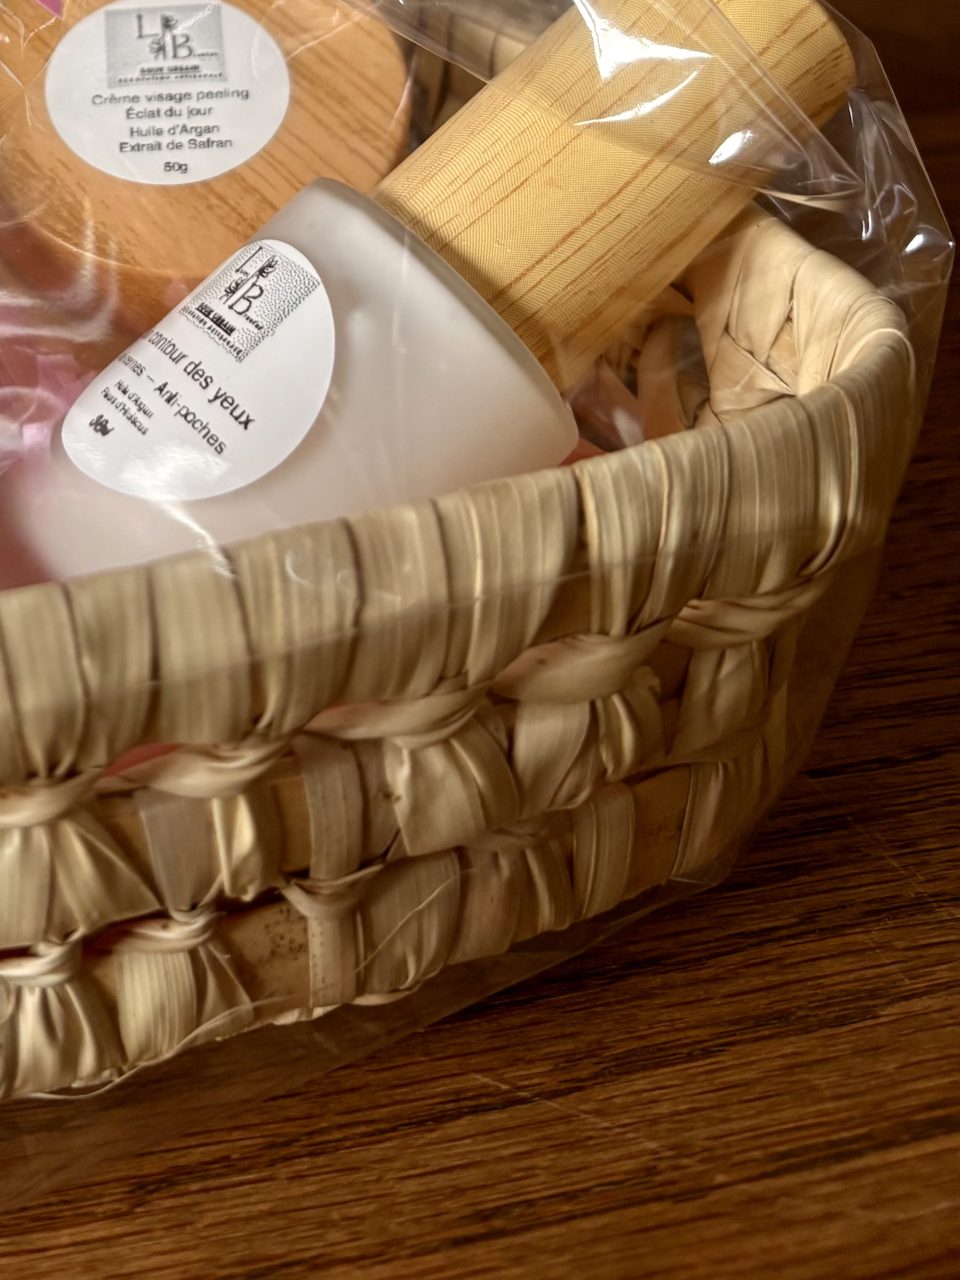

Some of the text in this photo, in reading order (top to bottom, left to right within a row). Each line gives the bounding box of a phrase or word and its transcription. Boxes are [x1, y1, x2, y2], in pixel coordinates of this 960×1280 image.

[91, 88, 250, 106] Crème visage peeling
[125, 105, 214, 120] Éclat du jour
[129, 123, 220, 138] Huile d'Argan
[119, 137, 233, 153] Extrait de Safran
[163, 161, 189, 174] 50g
[147, 330, 189, 365] contour
[183, 360, 214, 390] des
[207, 386, 256, 431] yeux
[153, 380, 227, 455] Anti-poches
